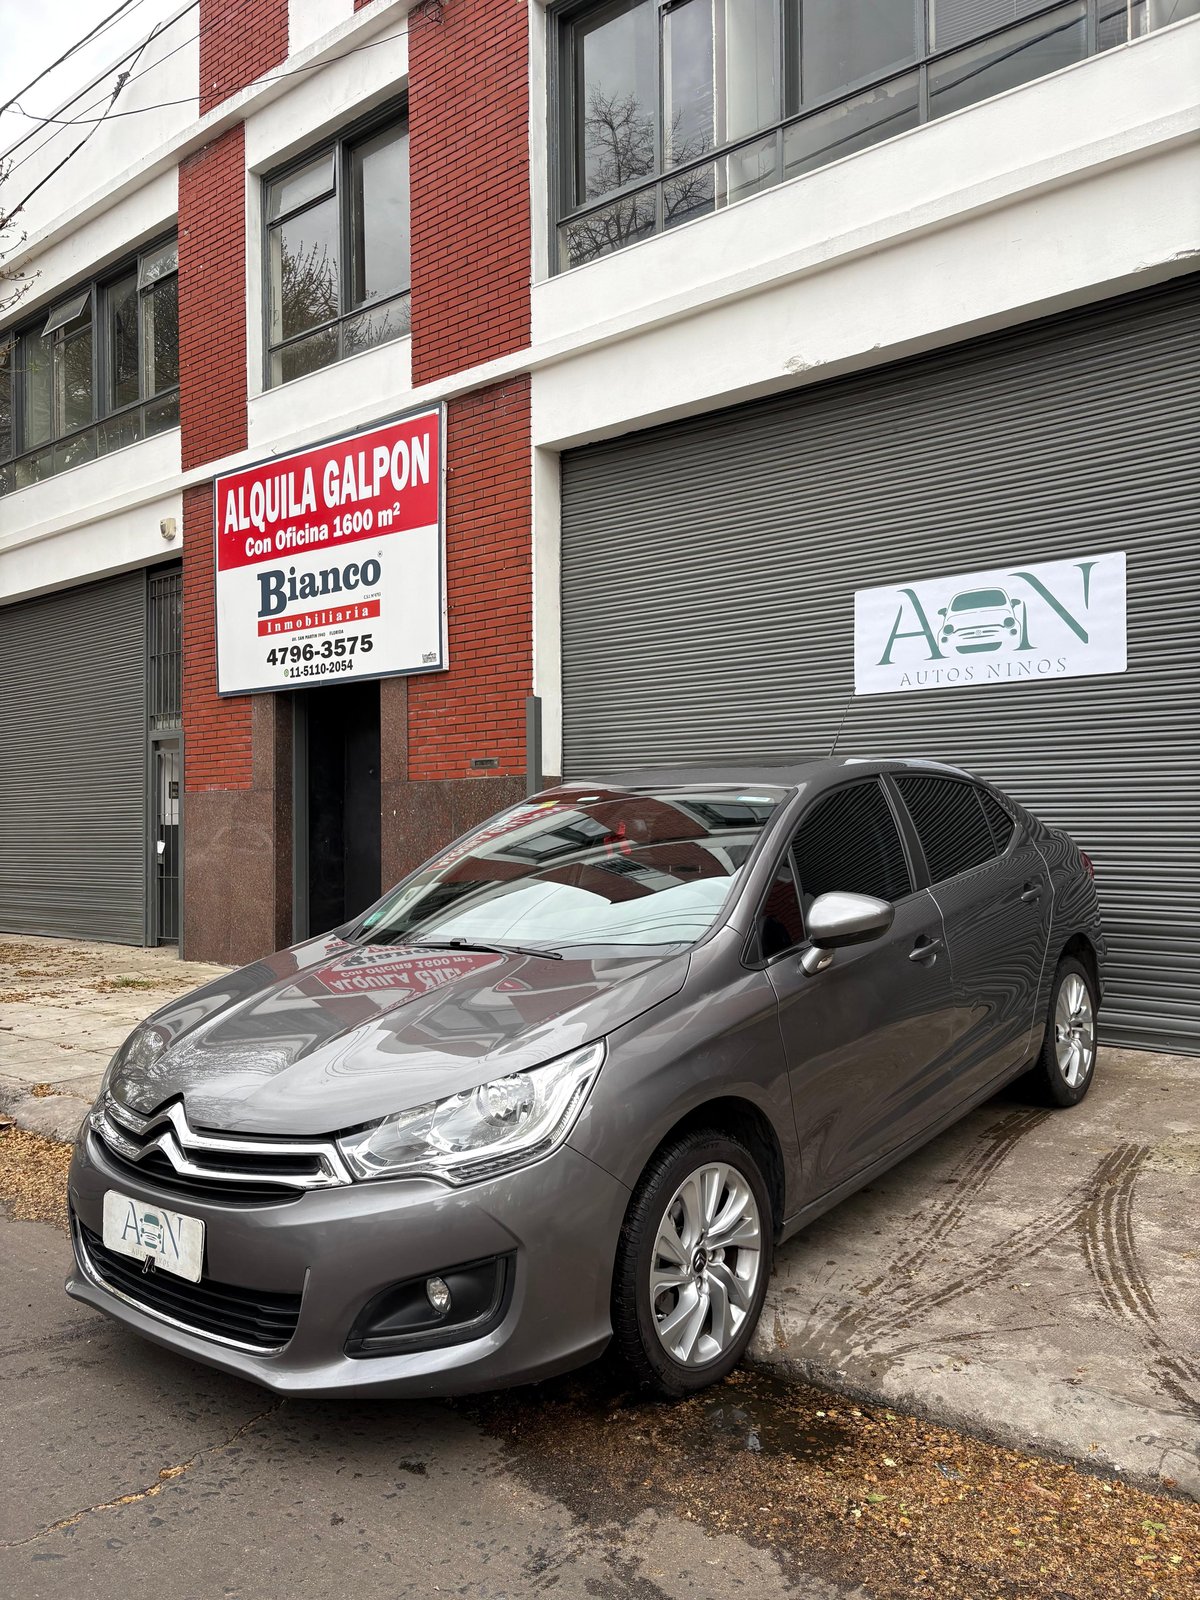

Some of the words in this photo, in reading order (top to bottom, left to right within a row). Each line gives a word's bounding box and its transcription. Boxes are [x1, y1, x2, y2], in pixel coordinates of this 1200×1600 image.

[224, 466, 317, 534] ALQUILA
[323, 433, 430, 508] GALPON
[245, 535, 272, 557] Con
[275, 522, 329, 551] Oficina
[333, 508, 373, 537] 1600
[257, 558, 381, 618] Bianco
[267, 605, 369, 633] Inmobiliaria
[267, 634, 373, 666] 4796-3575
[289, 659, 353, 678] 11-5110-2054
[900, 666, 975, 686] AUTOS
[987, 657, 1067, 679] NINOS
